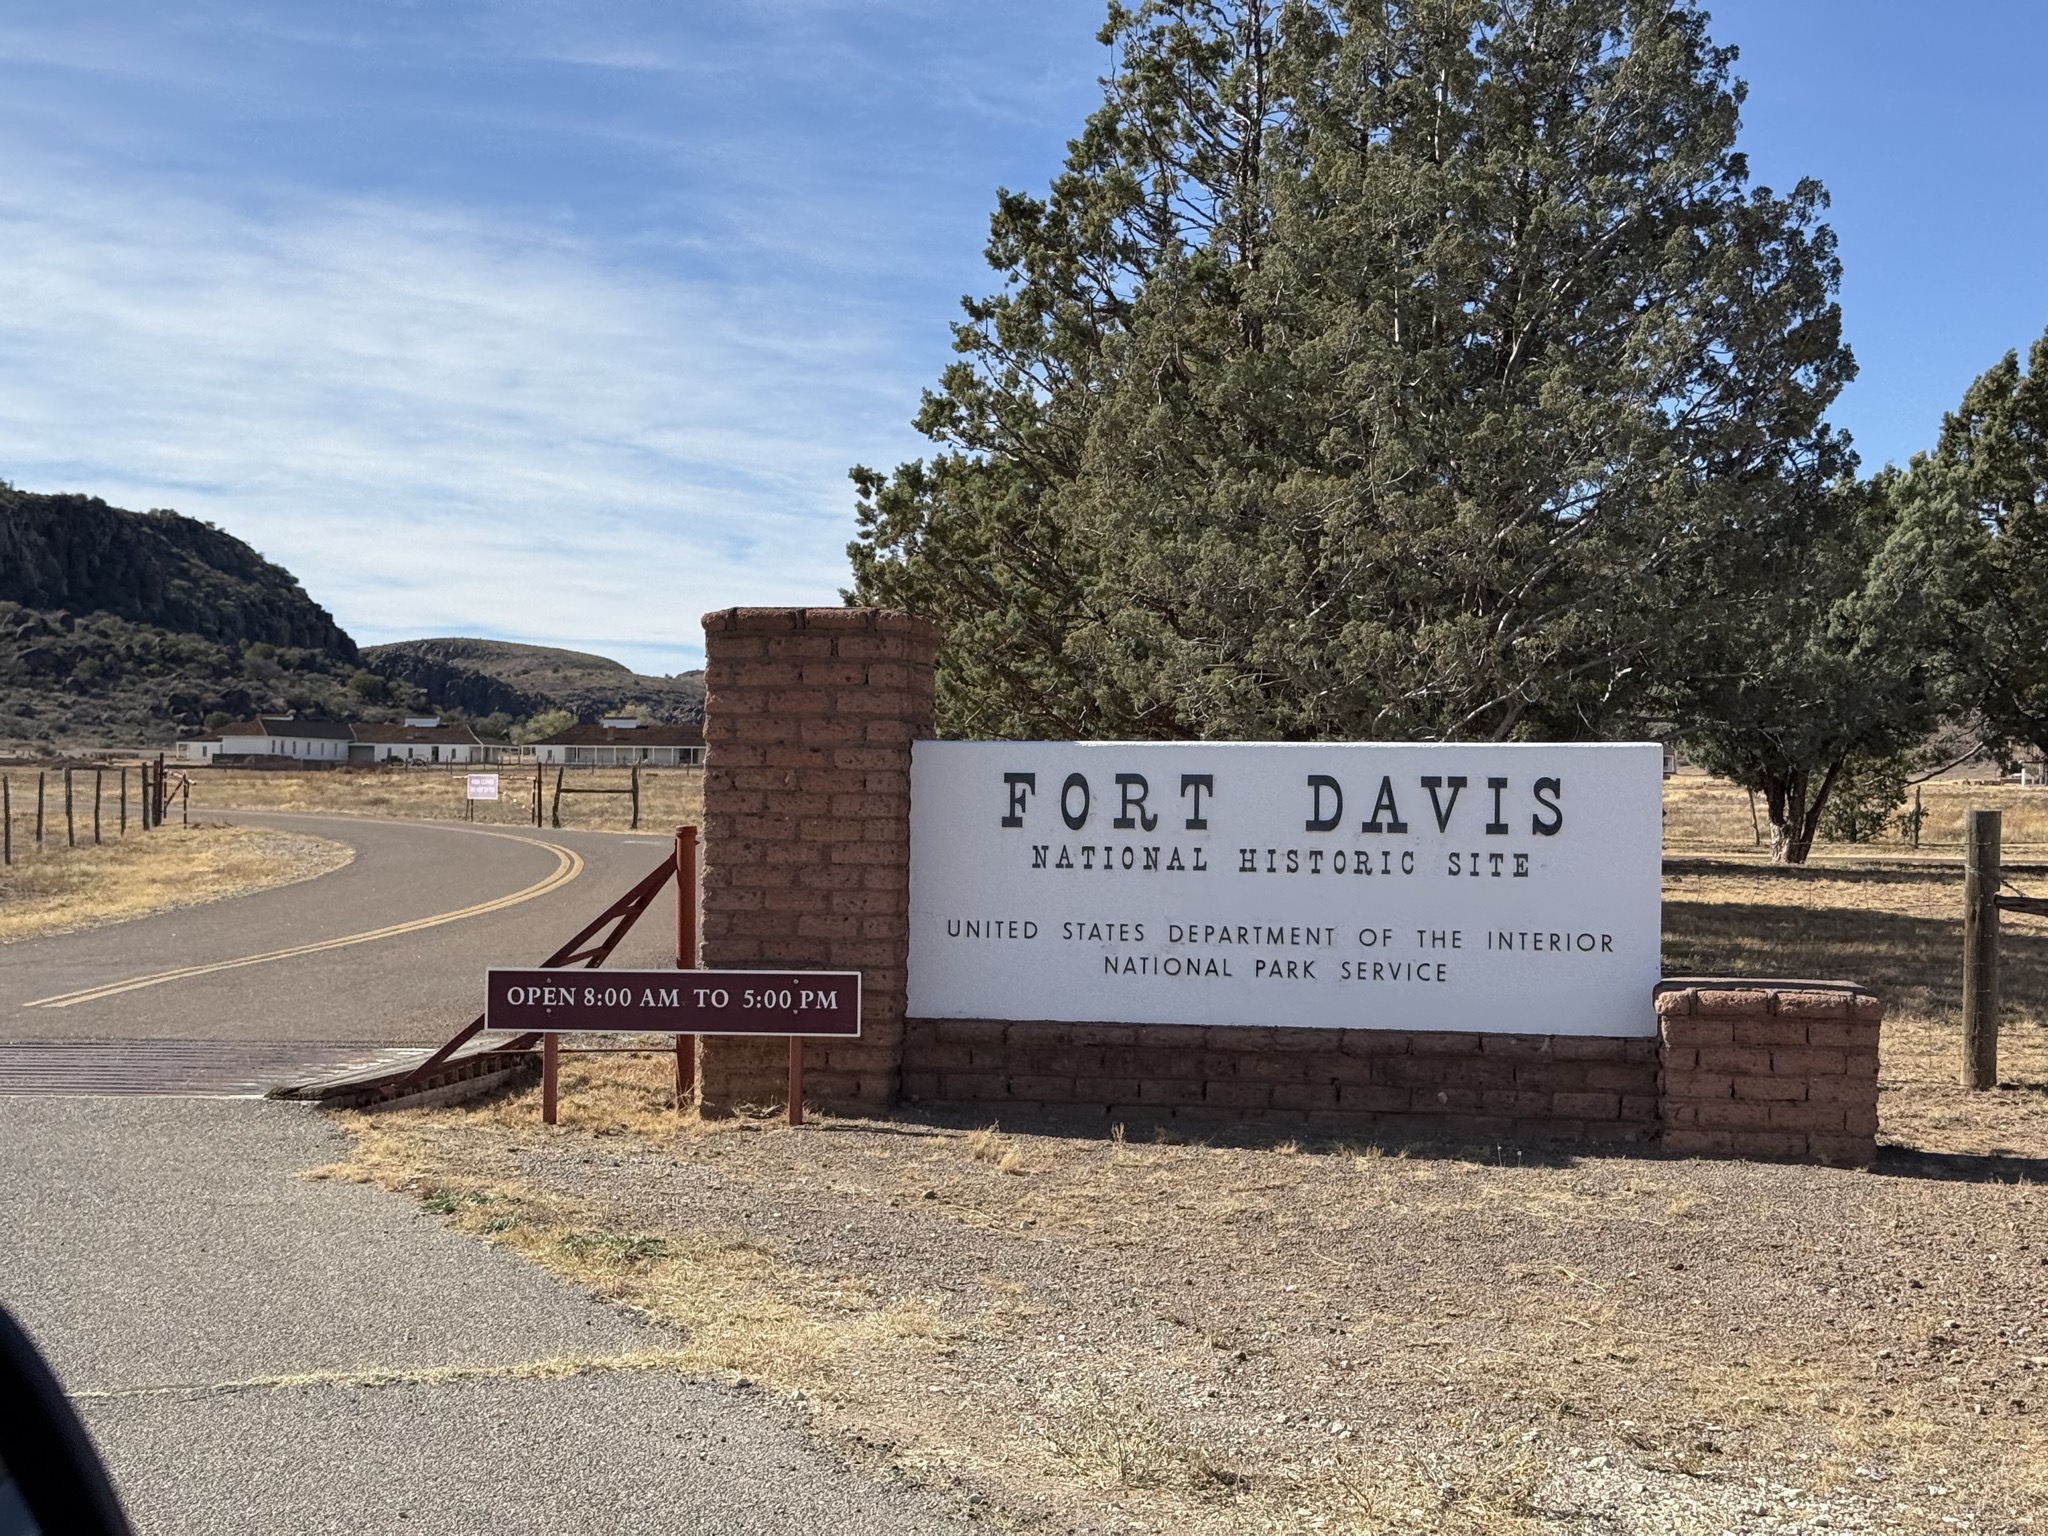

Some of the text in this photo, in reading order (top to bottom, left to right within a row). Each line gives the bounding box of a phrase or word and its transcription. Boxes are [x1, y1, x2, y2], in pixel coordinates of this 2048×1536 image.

[1002, 773, 1564, 836] FORT DAVIS
[1032, 845, 1529, 878] NATIONAL HISTORIC SITE
[947, 919, 1614, 953] UNITED STATES DEPARTMENT OF THE INTERIOR
[1104, 956, 1447, 982] NATIONAL PARK SERVICE
[507, 986, 838, 1010] OPEN 8:00 AM TO 5:00 PM
